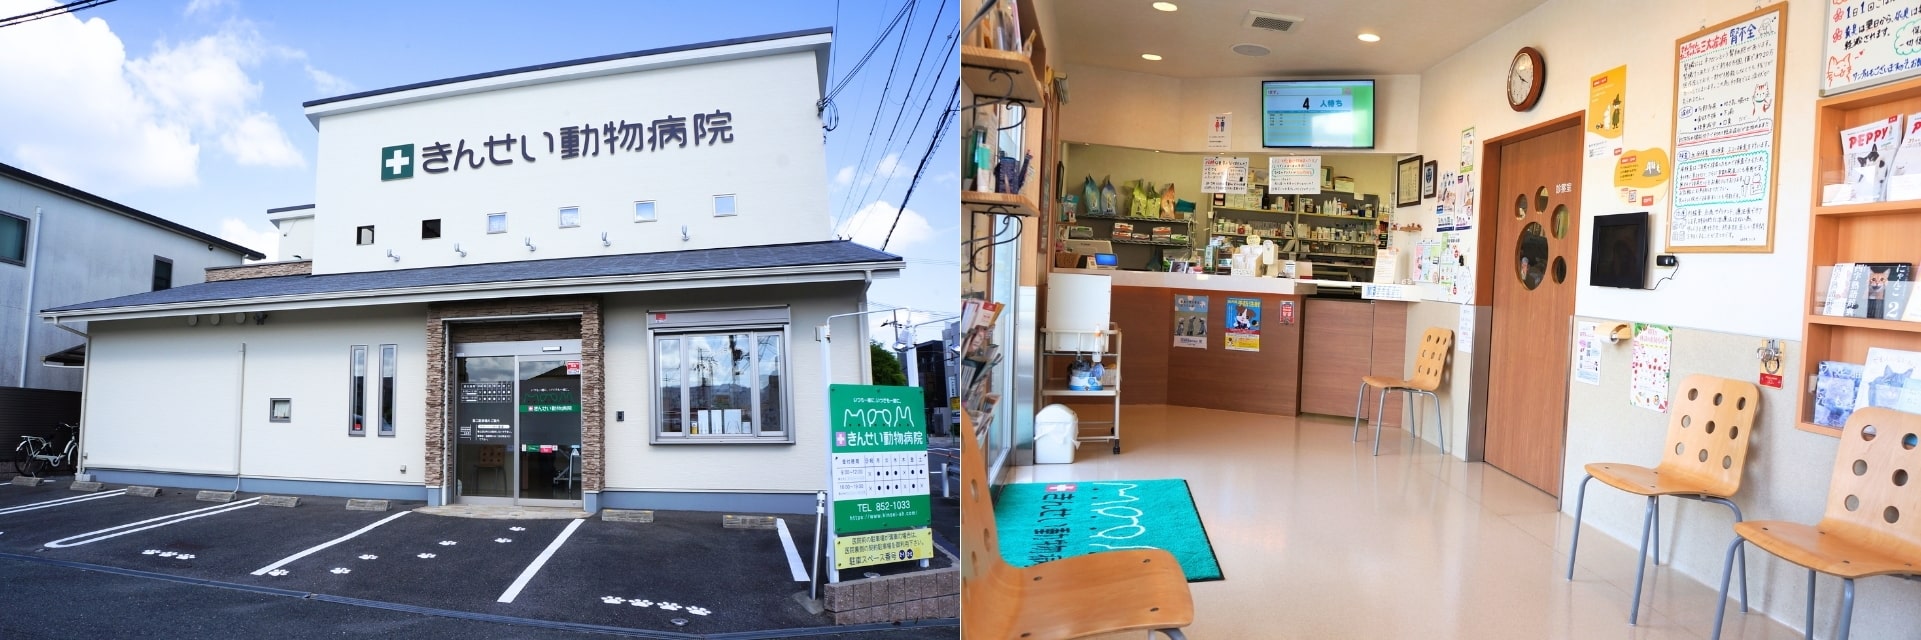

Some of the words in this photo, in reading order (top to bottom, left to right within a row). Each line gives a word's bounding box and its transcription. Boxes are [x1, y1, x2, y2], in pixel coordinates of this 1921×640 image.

[1729, 24, 1757, 45] 腎不全
[1302, 97, 1310, 110] 4
[1320, 99, 1343, 108] 人待ち
[421, 108, 735, 174] きんせい動物病院
[1848, 126, 1889, 149] PEPPY
[1886, 302, 1899, 318] 2
[847, 431, 923, 447] きんせい動物病院
[857, 503, 872, 512] TEL
[876, 500, 911, 511] 852-1033
[849, 551, 897, 566] 駐車スペース番号
